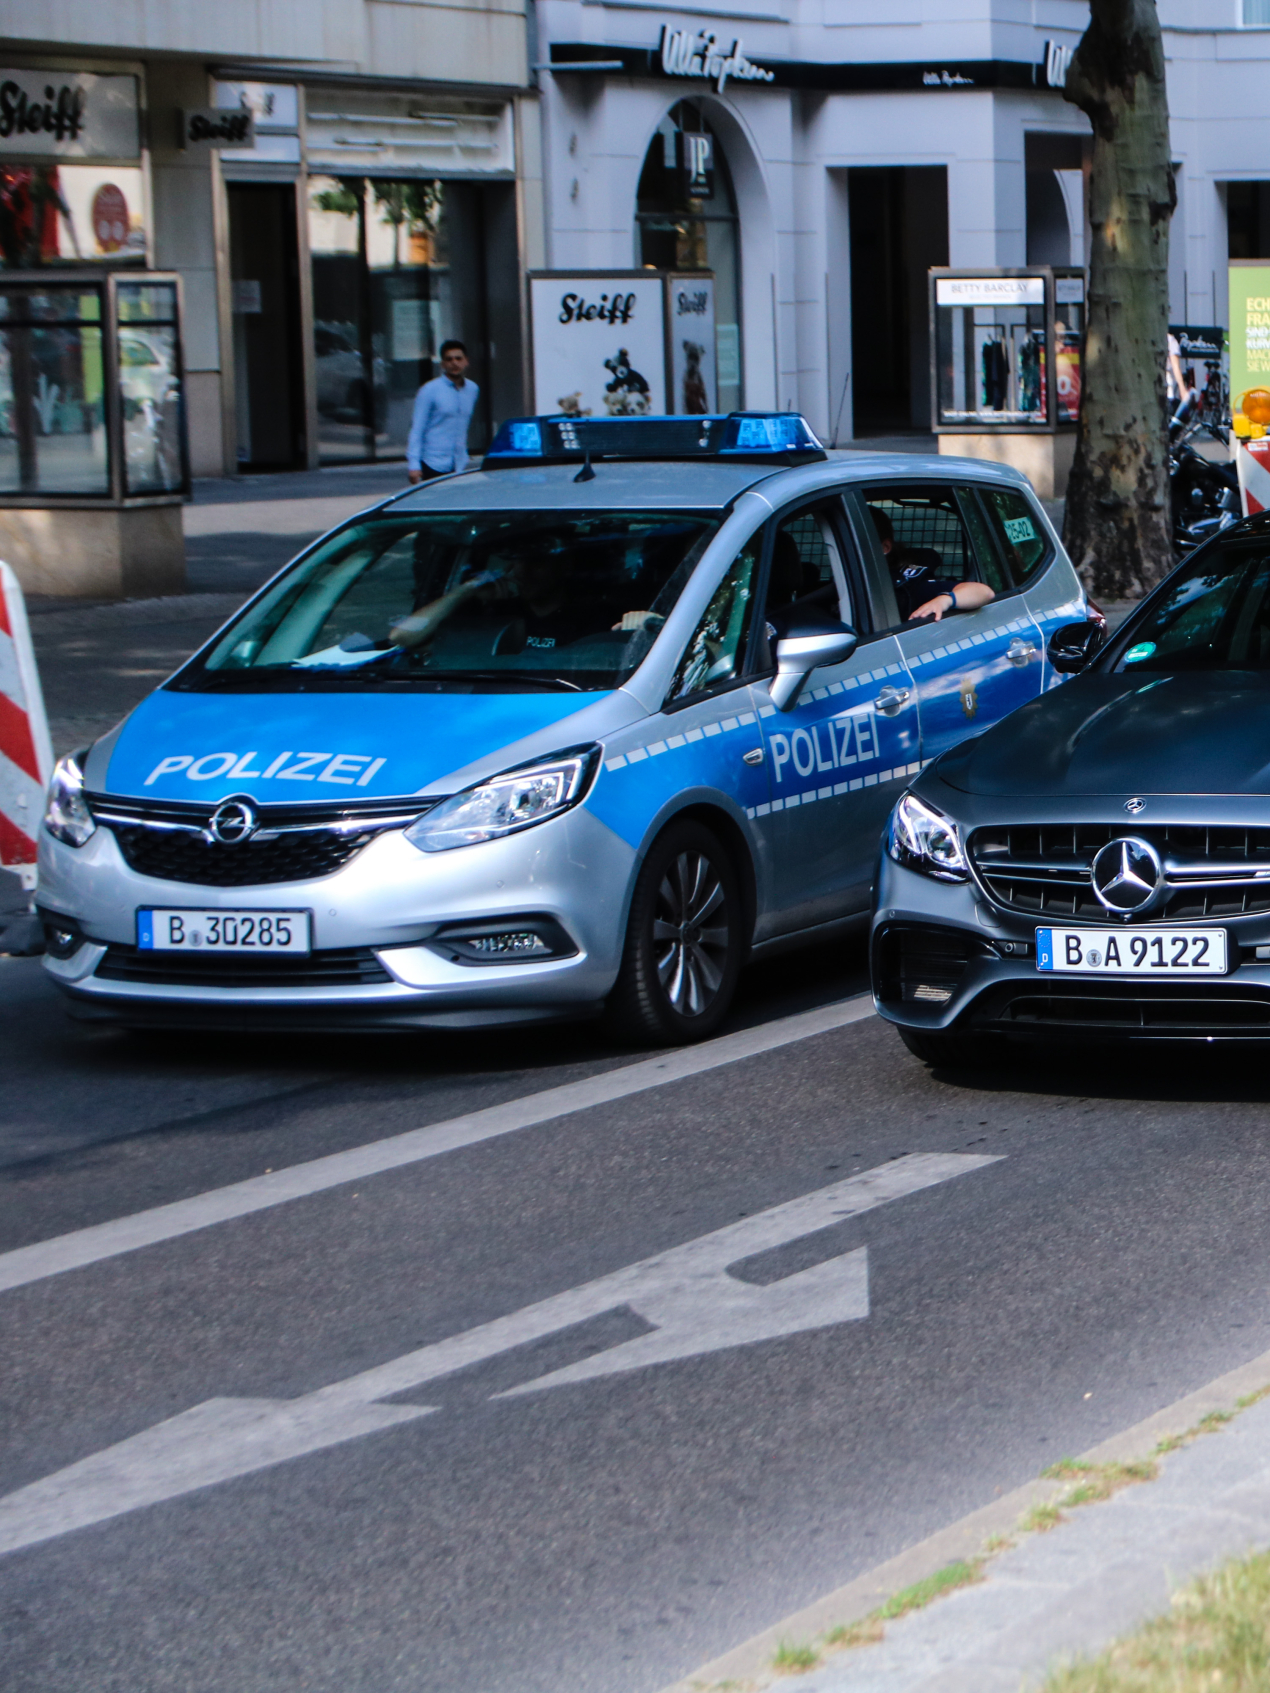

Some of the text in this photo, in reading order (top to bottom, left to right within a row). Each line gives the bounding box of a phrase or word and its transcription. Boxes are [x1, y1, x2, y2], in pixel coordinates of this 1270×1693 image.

[0, 80, 84, 141] Steiff
[951, 283, 1029, 294] BETTY BARCLAY
[558, 292, 636, 325] Steiff
[1246, 360, 1260, 372] SIE
[769, 711, 880, 783] POLIZEI
[143, 751, 388, 786] POLIZEI
[169, 915, 185, 945] B
[206, 916, 292, 946] 30285
[1041, 934, 1210, 967] D B A 9122
